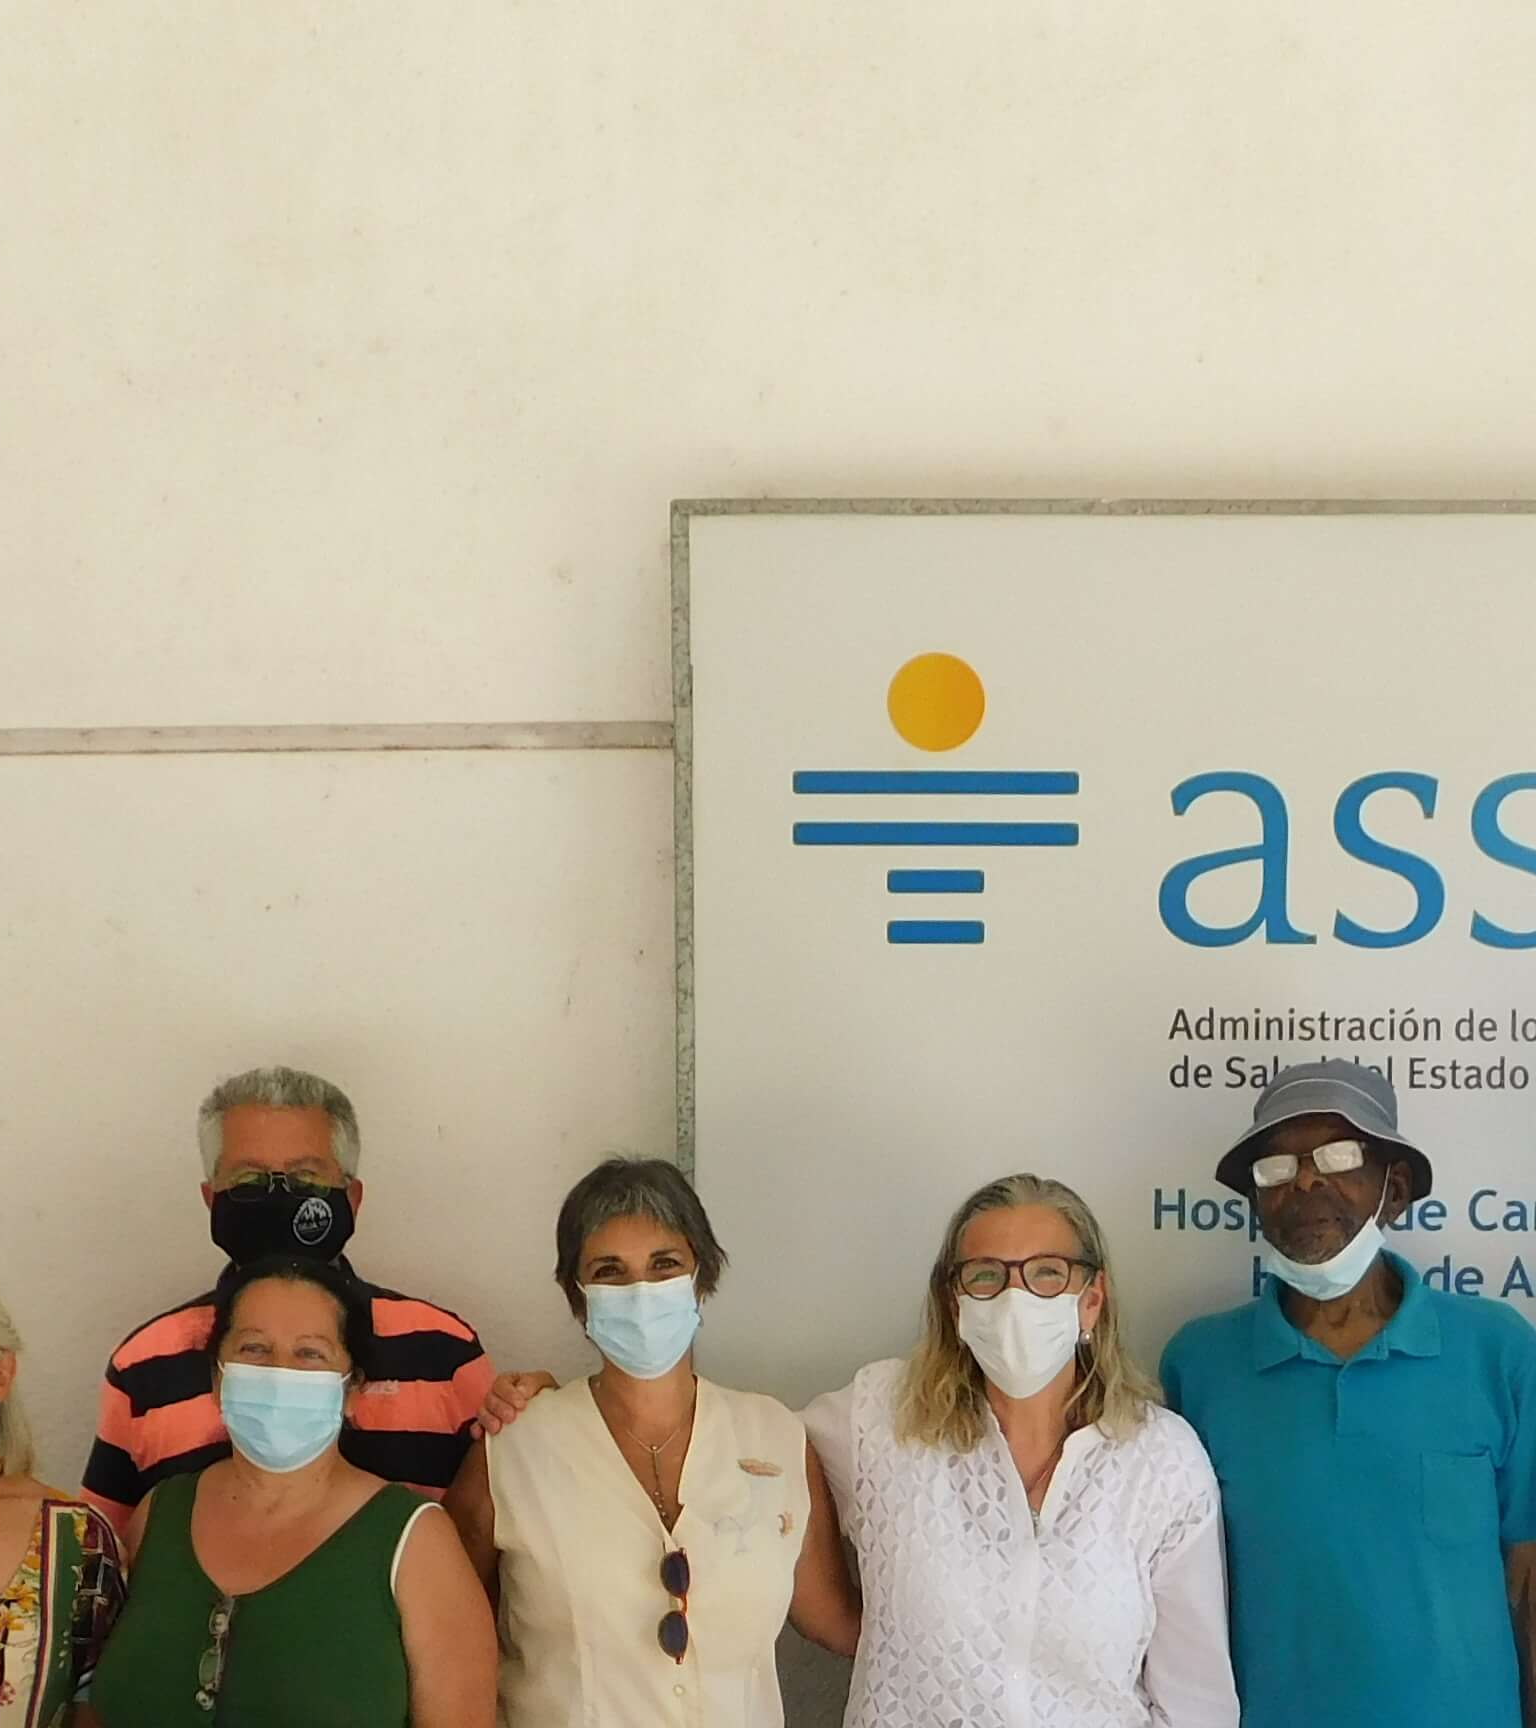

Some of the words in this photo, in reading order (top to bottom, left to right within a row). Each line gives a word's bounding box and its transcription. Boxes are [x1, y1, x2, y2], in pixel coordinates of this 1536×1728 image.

[1168, 1006, 1442, 1042] Administración
[1454, 1008, 1498, 1043] de
[1169, 1055, 1213, 1088] de
[1408, 1056, 1530, 1090] Estado
[1422, 1255, 1484, 1297] de
